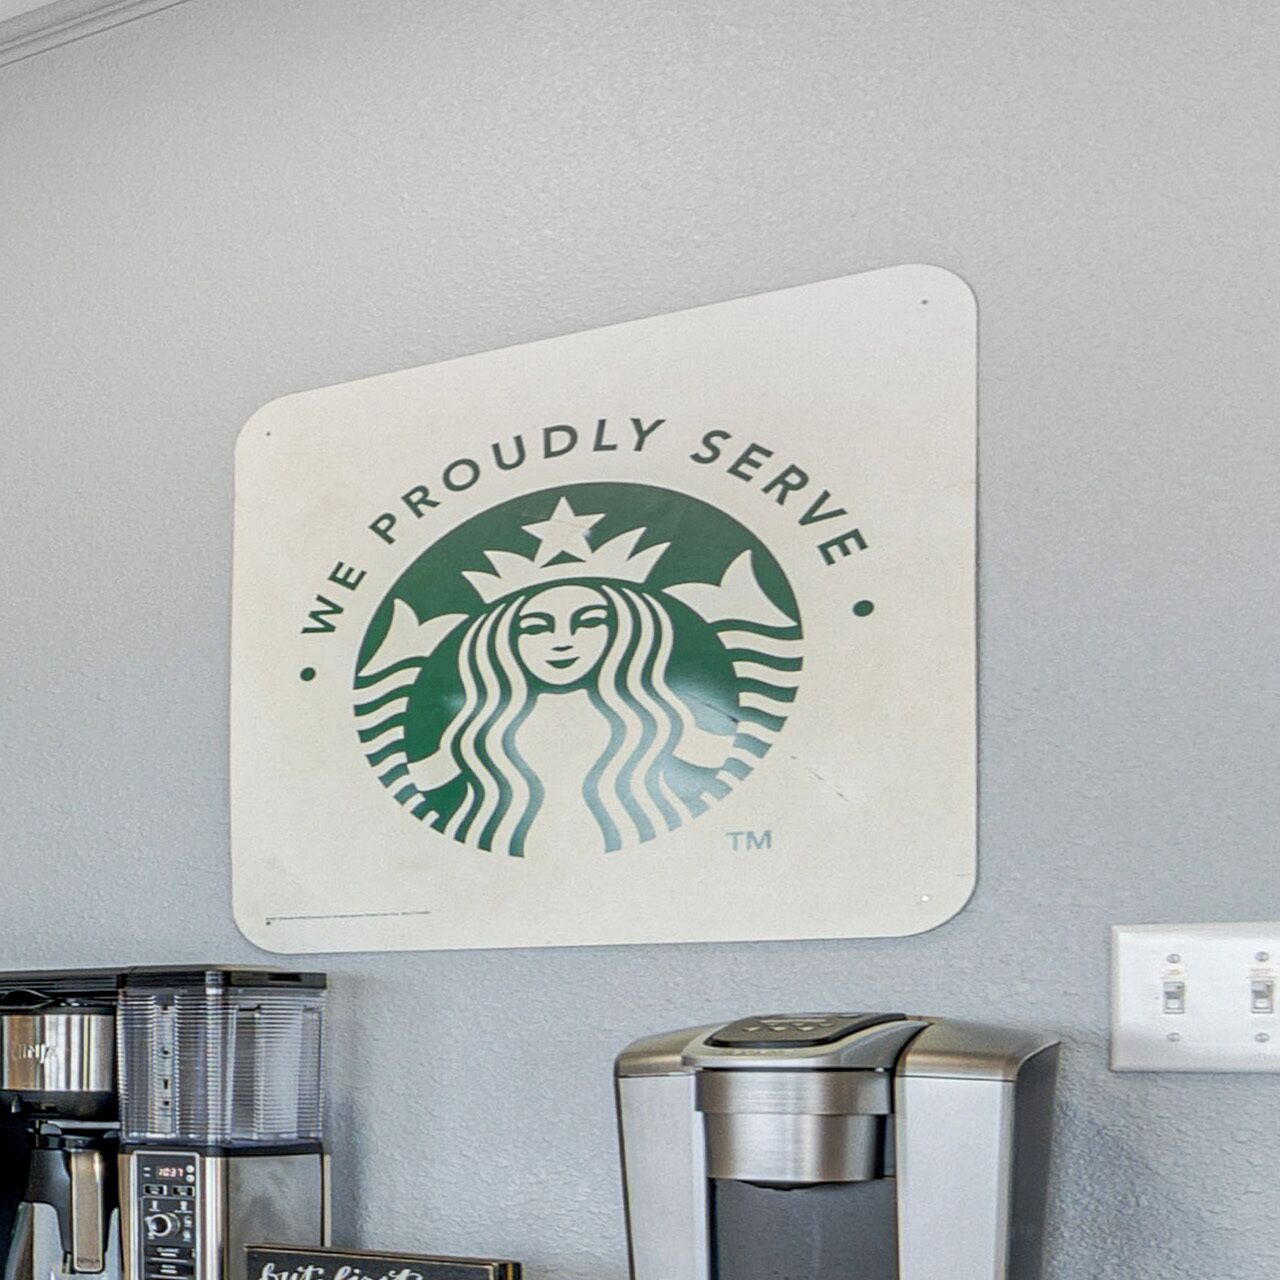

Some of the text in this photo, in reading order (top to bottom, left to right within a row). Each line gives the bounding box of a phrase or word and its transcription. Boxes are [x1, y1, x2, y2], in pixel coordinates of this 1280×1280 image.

[300, 417, 869, 637] WE PROUDLY SERVE
[725, 829, 773, 851] TM
